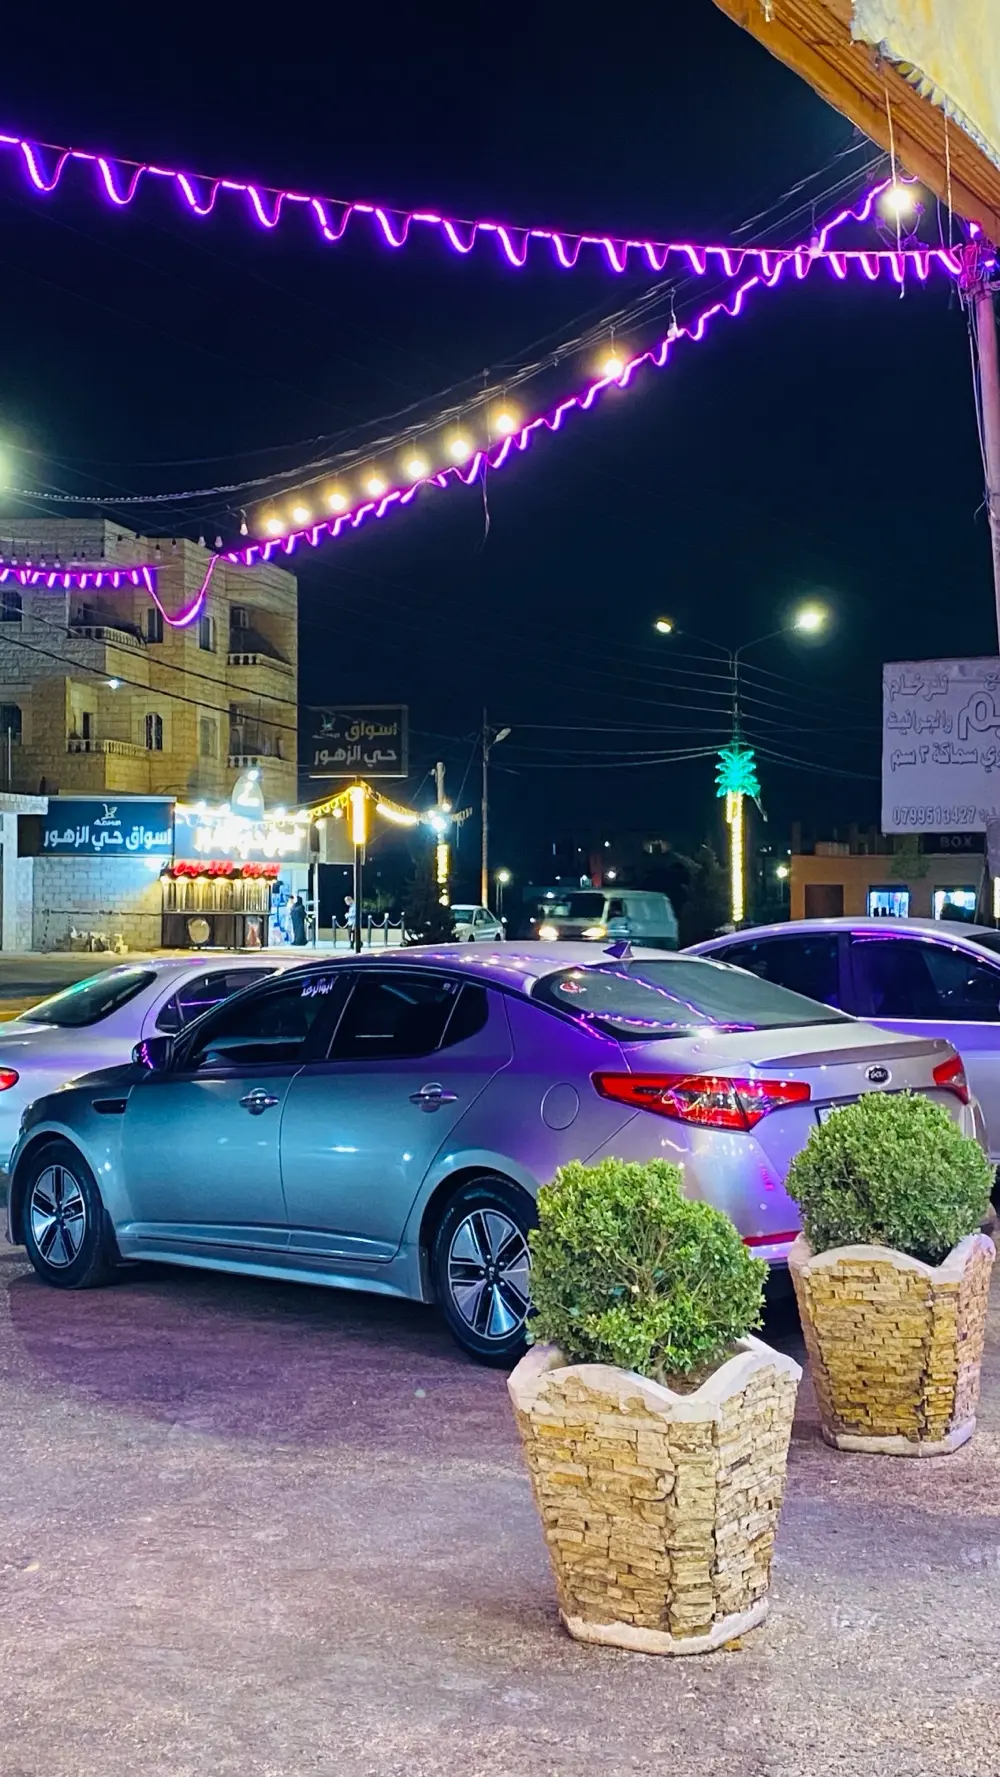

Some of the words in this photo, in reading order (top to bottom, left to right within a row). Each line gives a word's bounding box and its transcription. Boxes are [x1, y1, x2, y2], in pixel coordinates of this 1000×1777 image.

[314, 745, 361, 765] الزهور
[363, 749, 397, 767] حي
[892, 805, 977, 826] 0799513427
[43, 826, 90, 848] الزهور
[91, 830, 124, 851] حي
[940, 836, 974, 849] BOX
